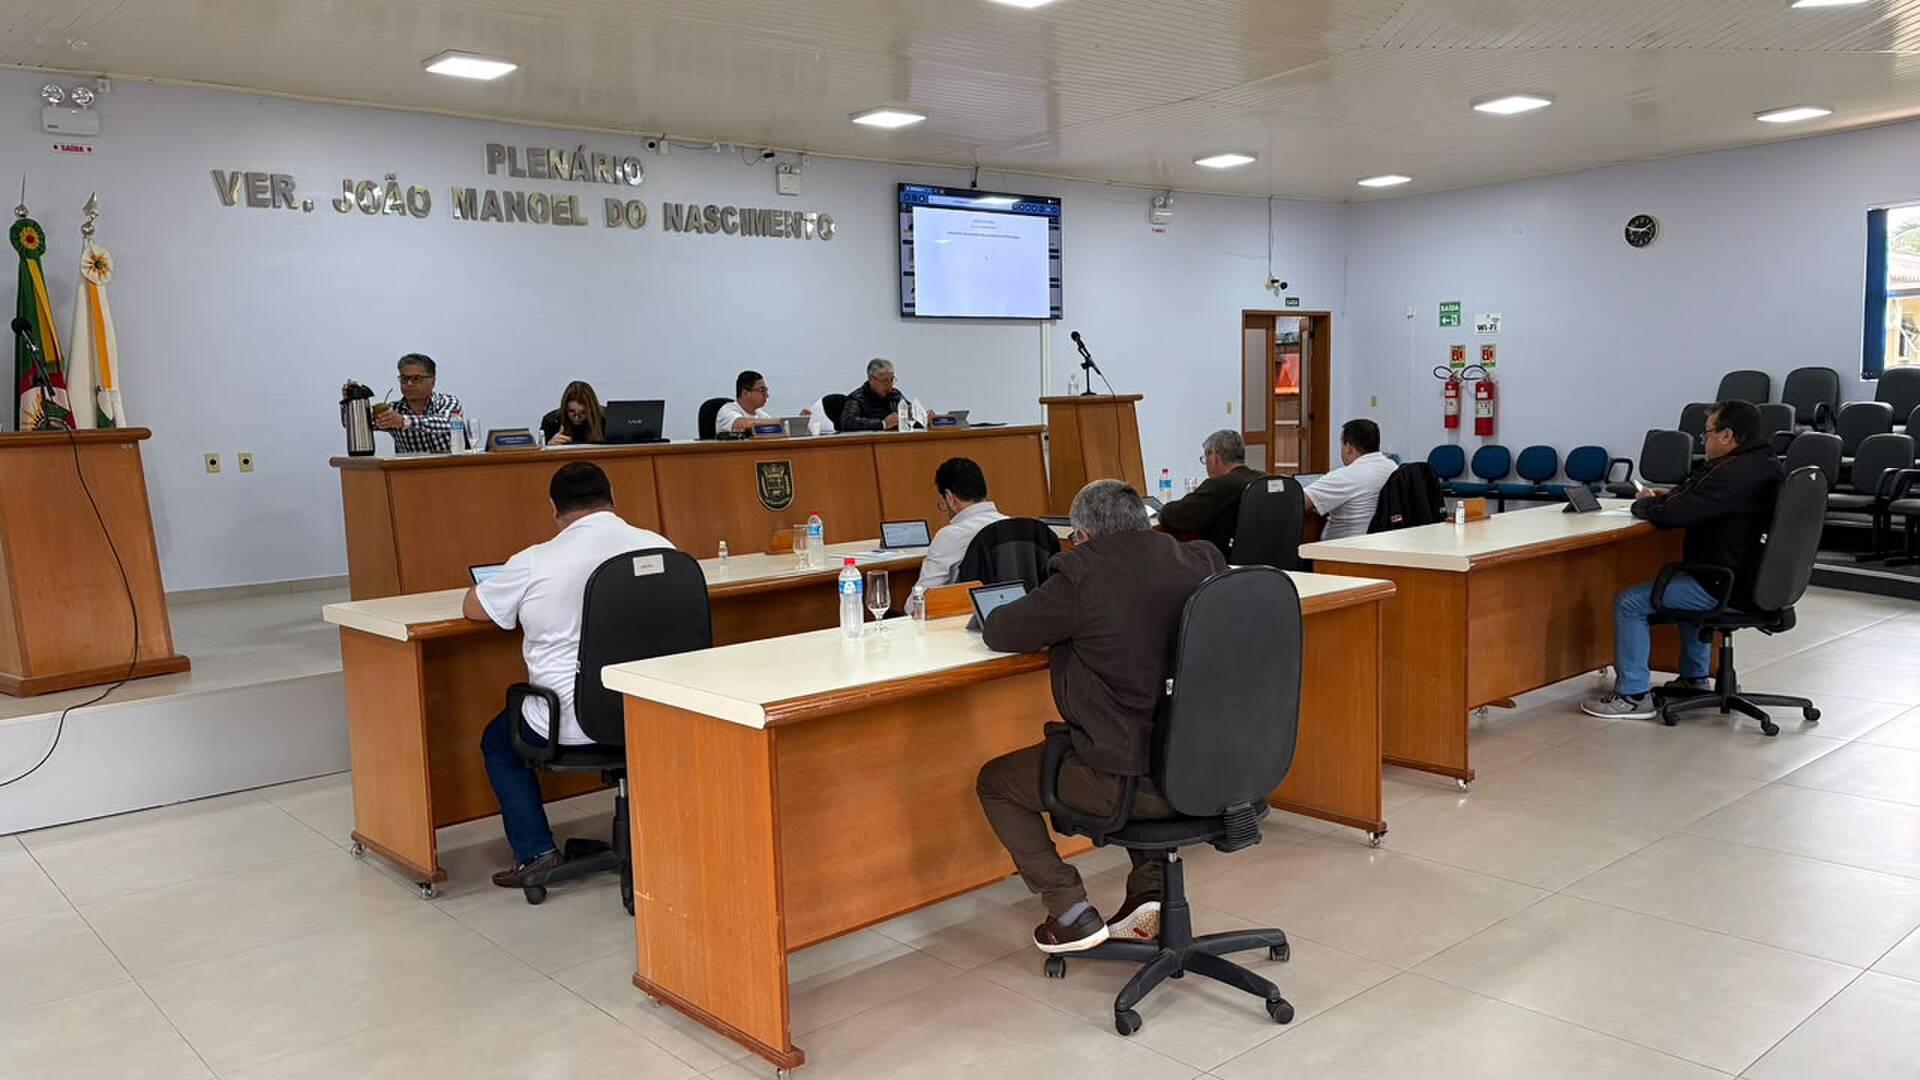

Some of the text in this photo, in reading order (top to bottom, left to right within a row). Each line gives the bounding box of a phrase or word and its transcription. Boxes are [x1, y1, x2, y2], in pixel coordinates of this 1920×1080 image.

[485, 143, 646, 187] PLENÁRIO
[210, 168, 837, 241] VER. JOÃO MANOEL DO NASCIMENTO
